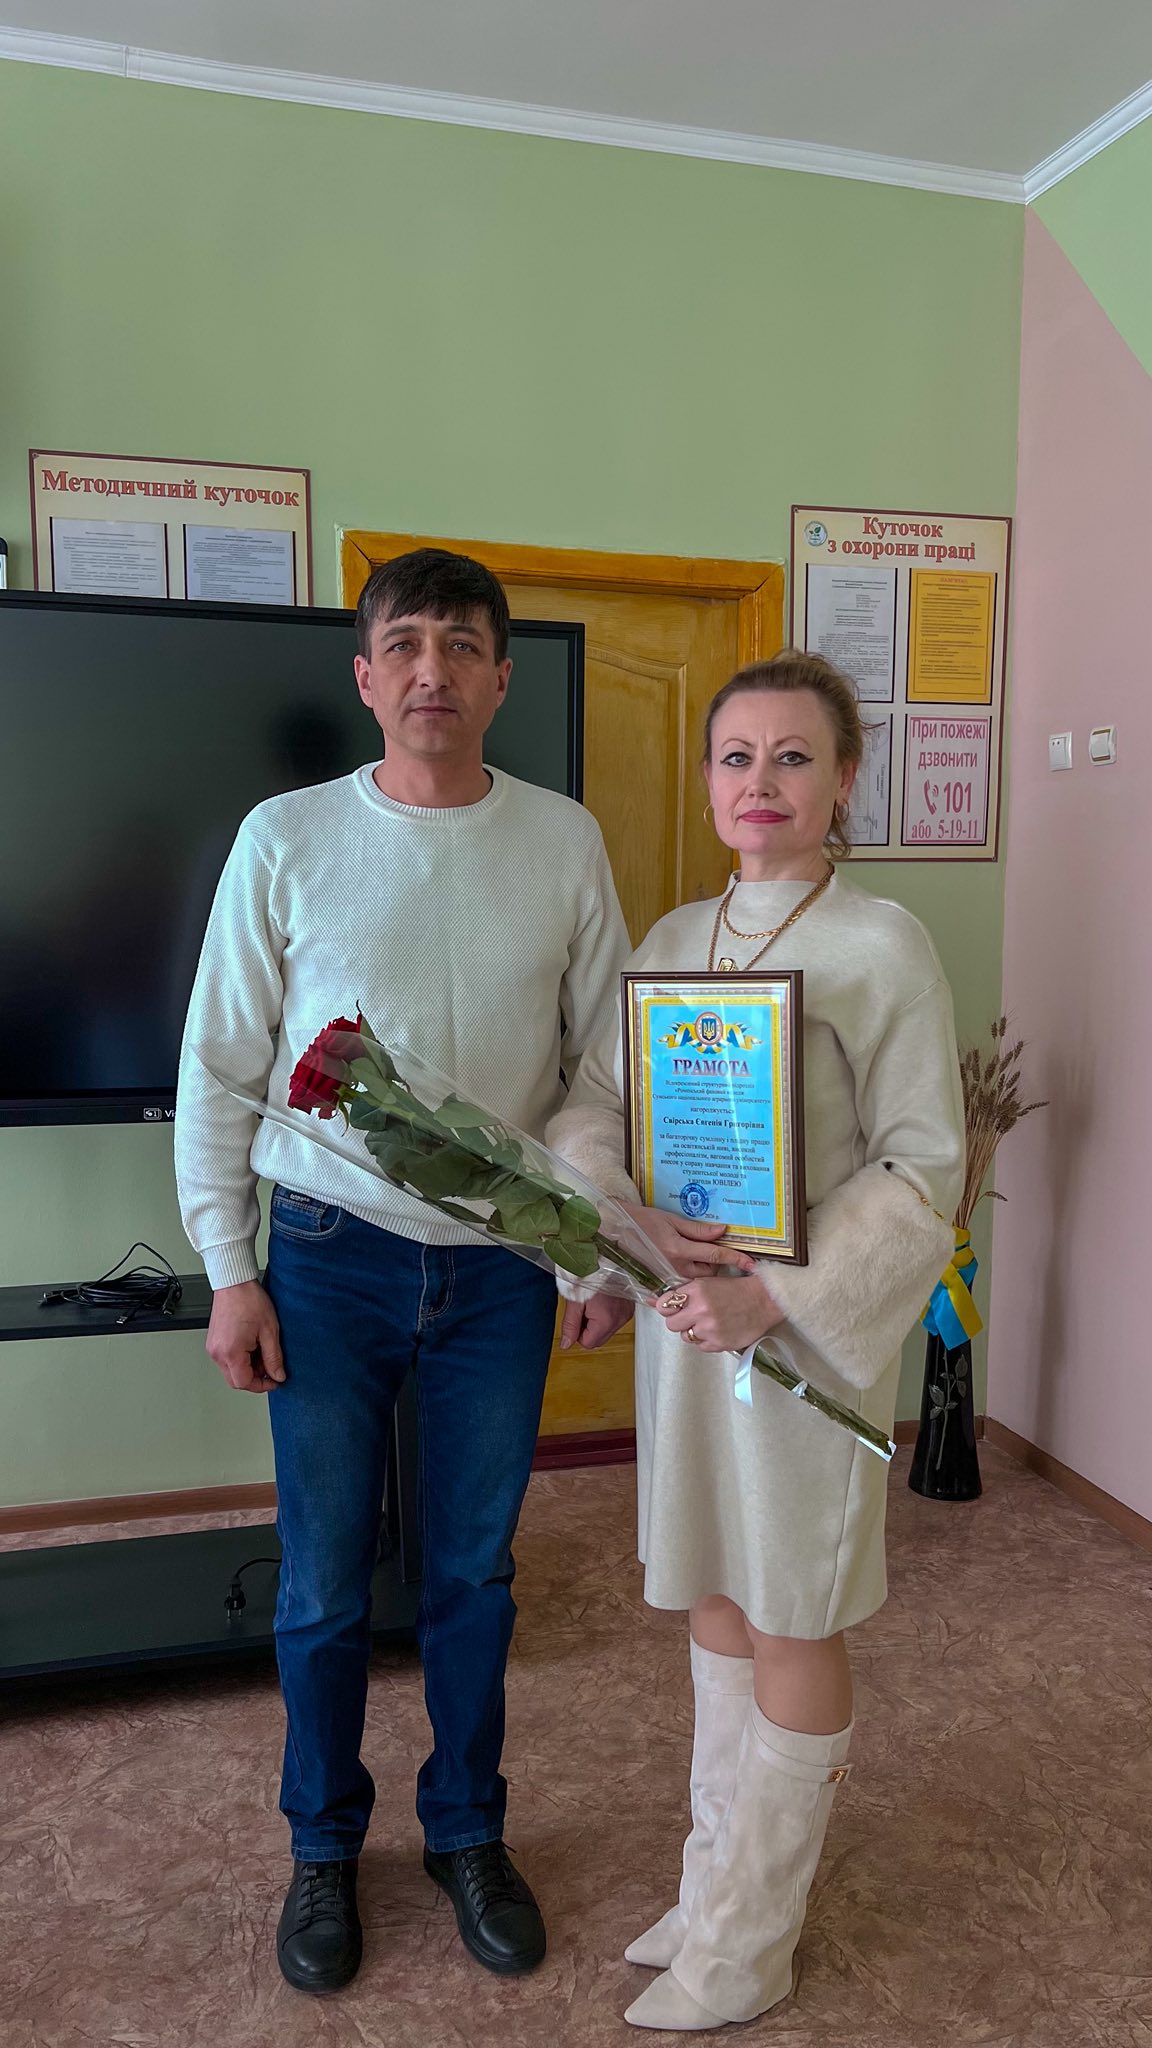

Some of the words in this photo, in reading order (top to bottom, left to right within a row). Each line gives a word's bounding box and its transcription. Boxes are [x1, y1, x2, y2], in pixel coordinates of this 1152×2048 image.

[42, 469, 197, 499] Методичний
[204, 484, 300, 507] куточок
[862, 516, 943, 541] Куточок
[827, 540, 837, 553] з
[842, 540, 919, 560] охорони
[924, 542, 976, 562] праці
[912, 720, 937, 743] При
[941, 722, 986, 740] пожежі
[918, 752, 978, 770] дзвонити
[943, 782, 972, 814] 101
[911, 819, 931, 839] або
[938, 819, 978, 839] 5-19-11
[672, 1059, 752, 1077] ГРАМОТА
